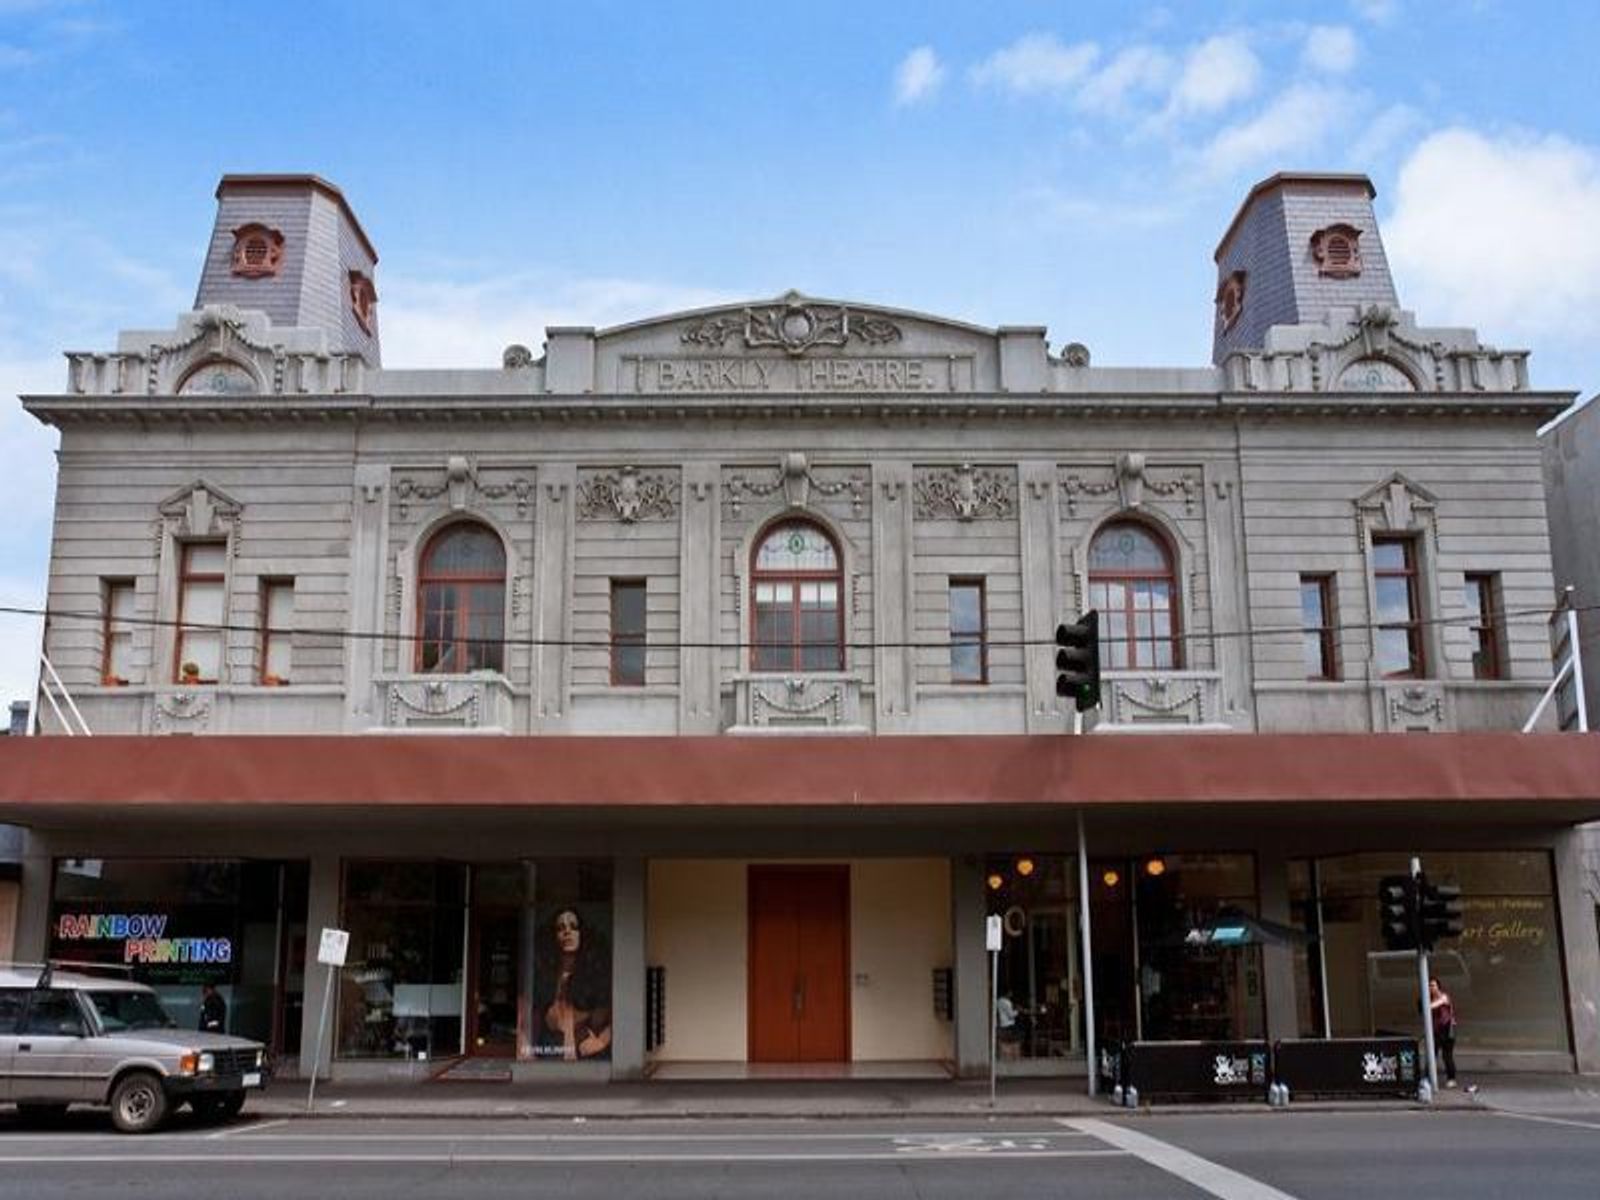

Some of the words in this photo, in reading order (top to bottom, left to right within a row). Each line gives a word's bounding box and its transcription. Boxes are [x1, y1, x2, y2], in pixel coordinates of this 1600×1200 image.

[657, 359, 770, 390] BARKLY
[59, 914, 167, 939] RAINBOW
[1487, 920, 1544, 946] Gallery
[124, 937, 232, 963] PRINTING
